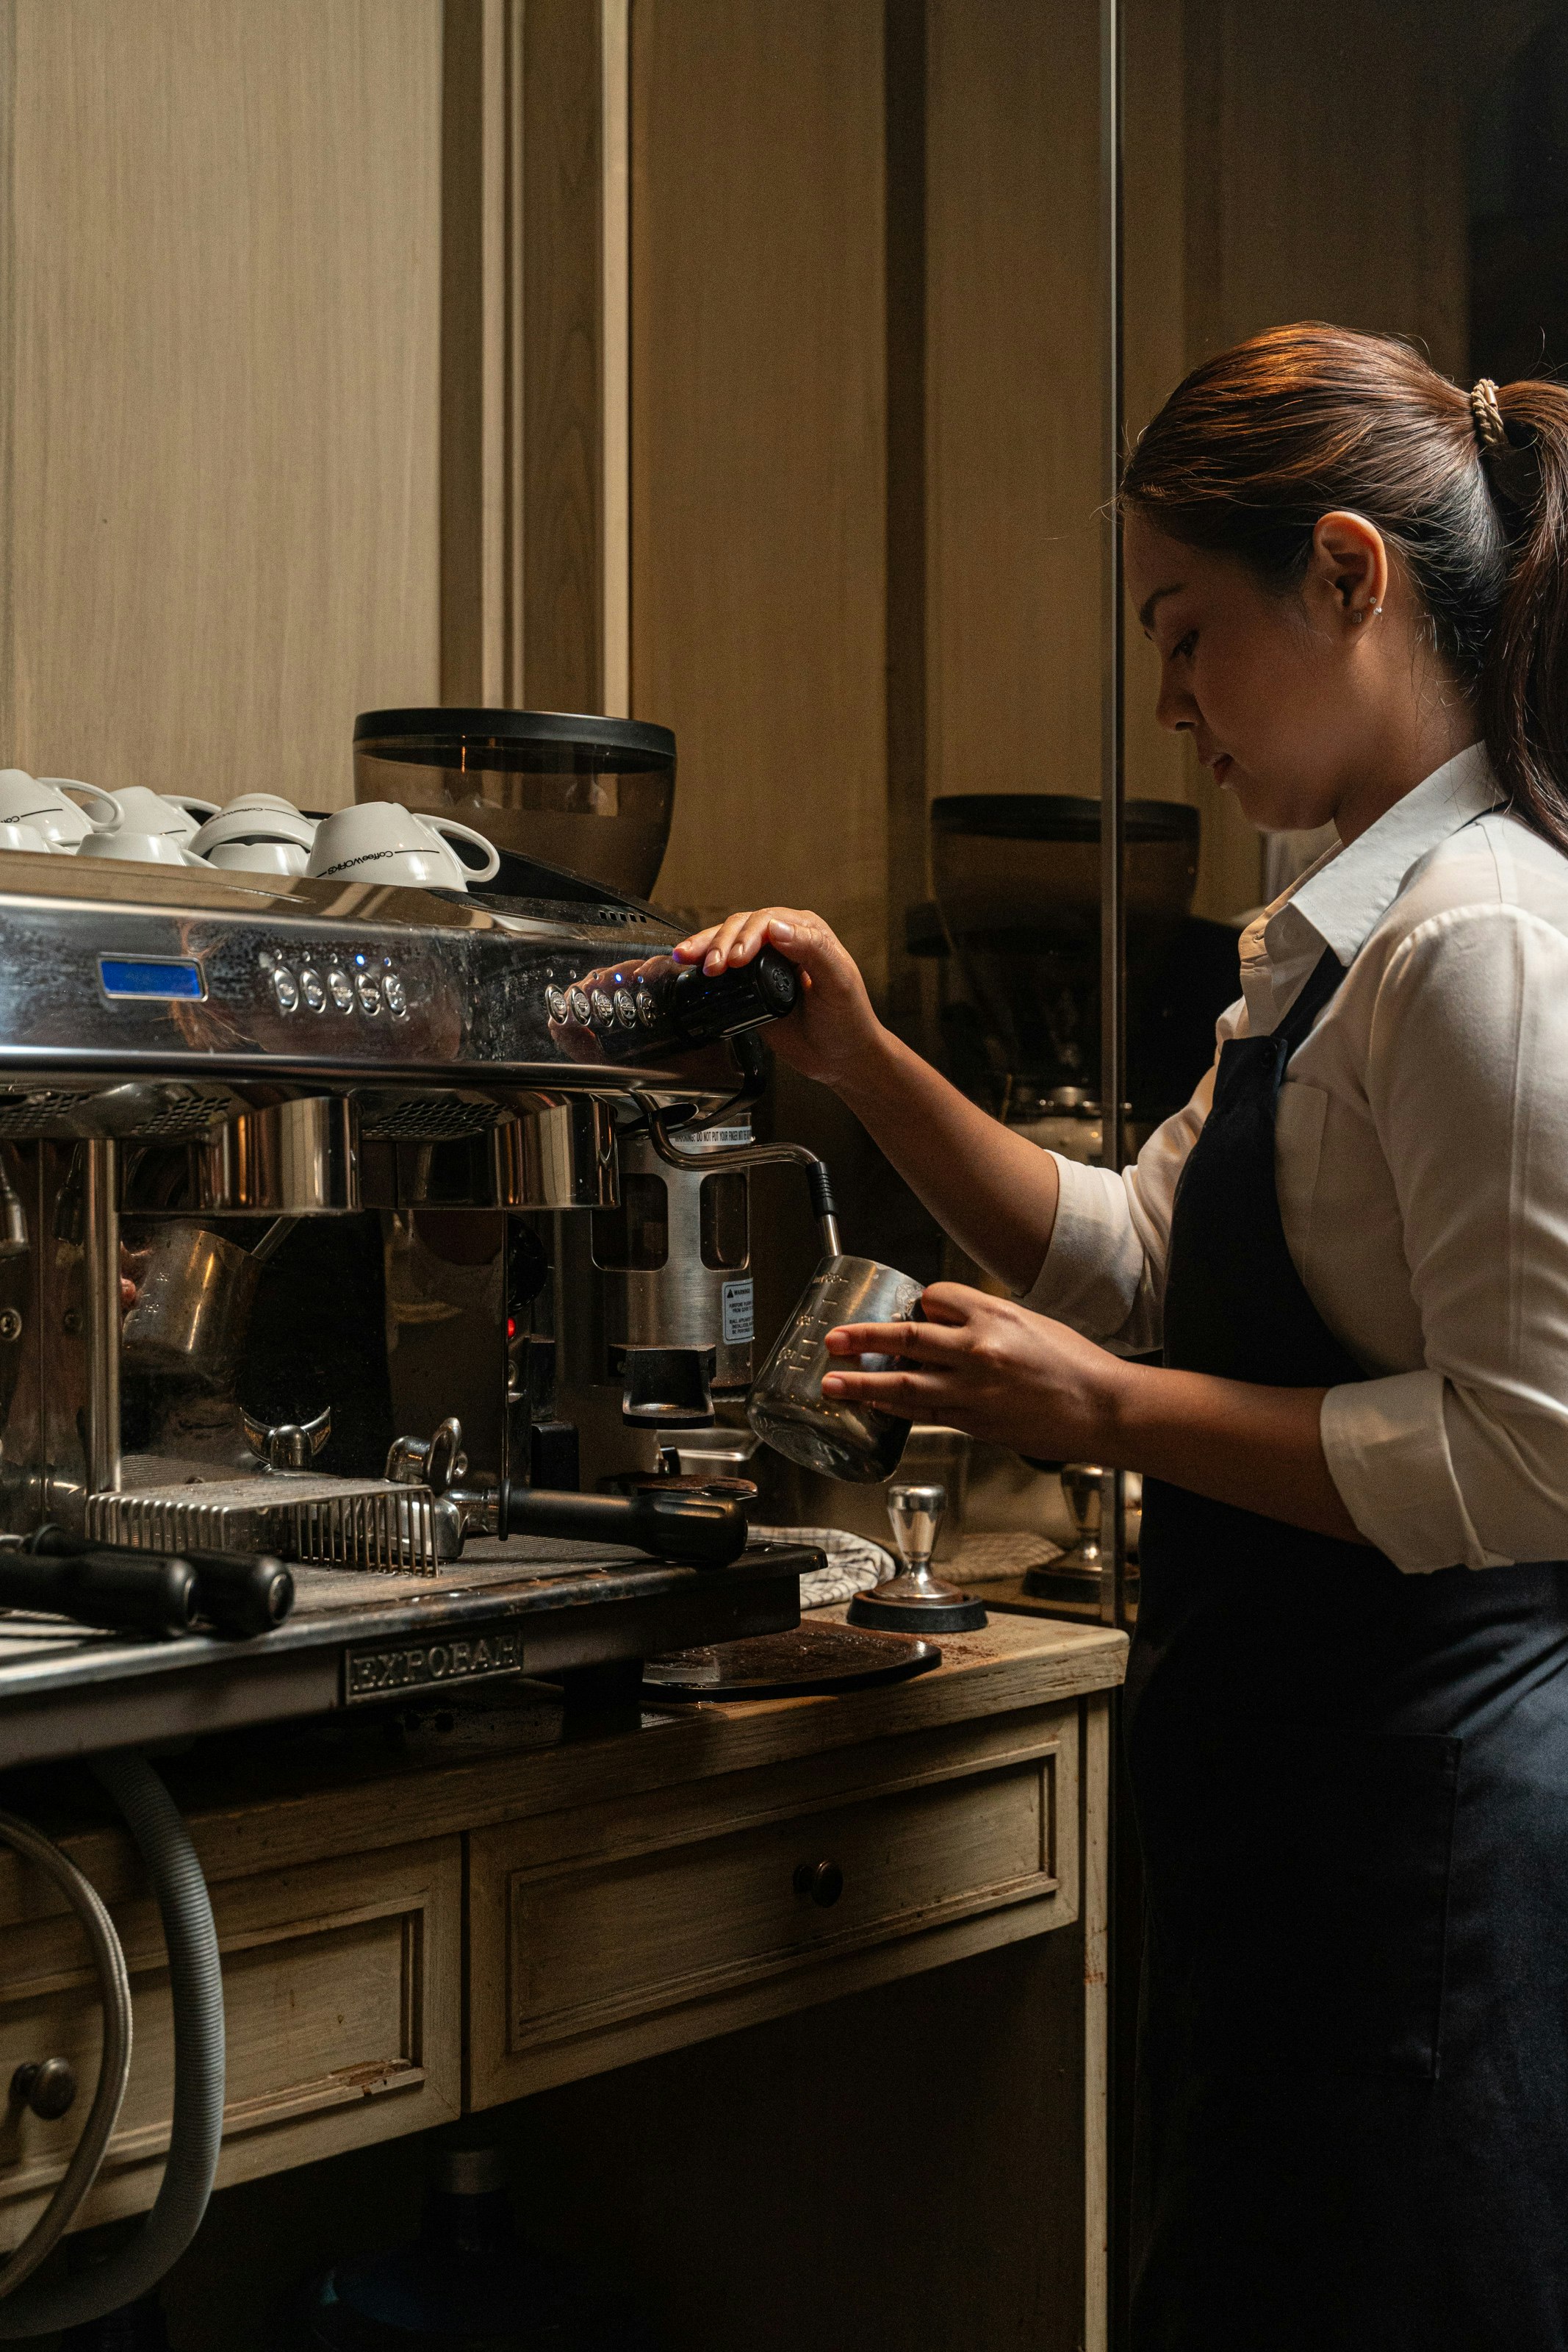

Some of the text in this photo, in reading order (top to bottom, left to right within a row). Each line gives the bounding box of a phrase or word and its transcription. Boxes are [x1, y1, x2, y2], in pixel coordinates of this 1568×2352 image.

[327, 850, 394, 875] CoffeeWORKS
[697, 1132, 703, 1141] DO
[719, 1131, 729, 1141] YOUR
[352, 1634, 517, 1691] EXPOBAR
